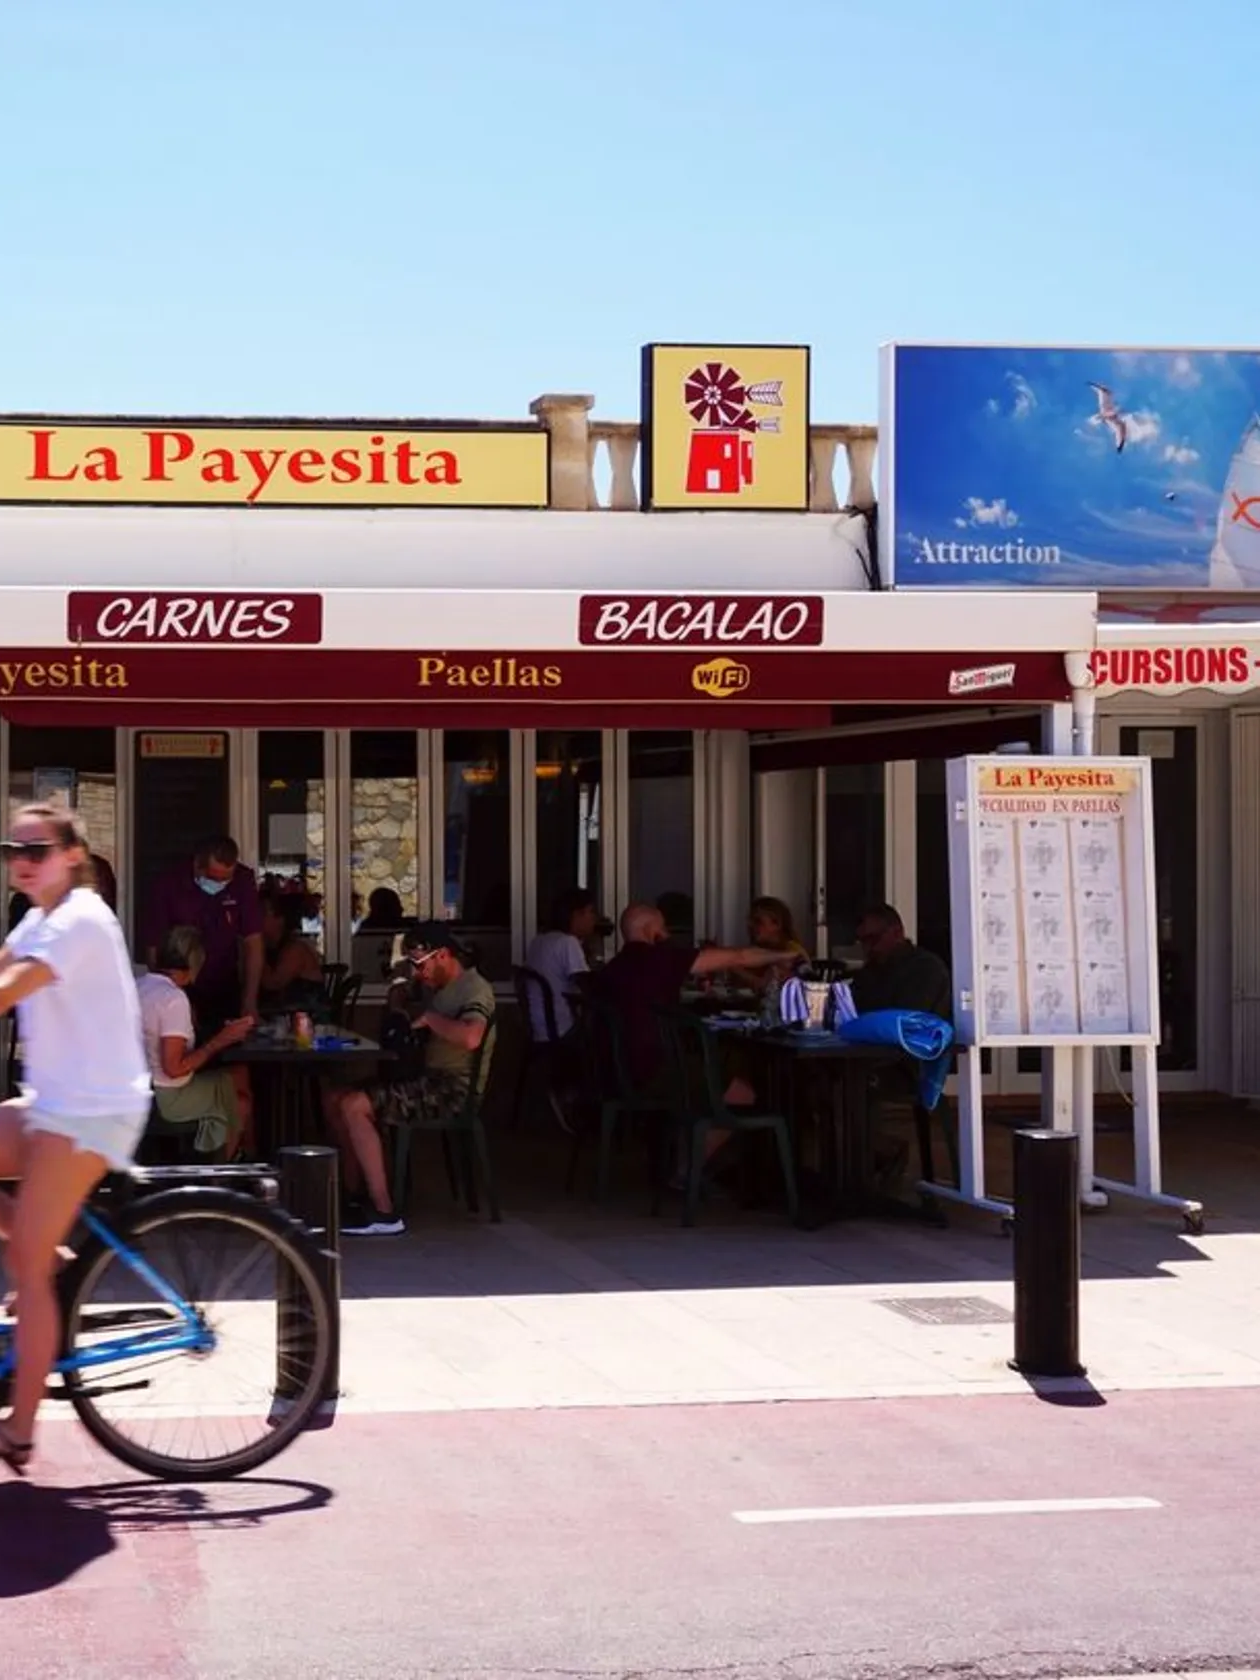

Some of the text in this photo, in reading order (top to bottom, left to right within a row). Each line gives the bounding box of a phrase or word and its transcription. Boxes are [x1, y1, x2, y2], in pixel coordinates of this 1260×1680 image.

[26, 430, 122, 482] La
[143, 430, 461, 504] Payesita
[915, 537, 1061, 564] Attraction
[95, 598, 294, 640] CARNES
[593, 601, 809, 643] BACALAO
[419, 656, 562, 687] Paellas
[994, 768, 1115, 792] La Payesita
[1052, 799, 1069, 813] EN
[1072, 799, 1121, 814] PAELLAS
